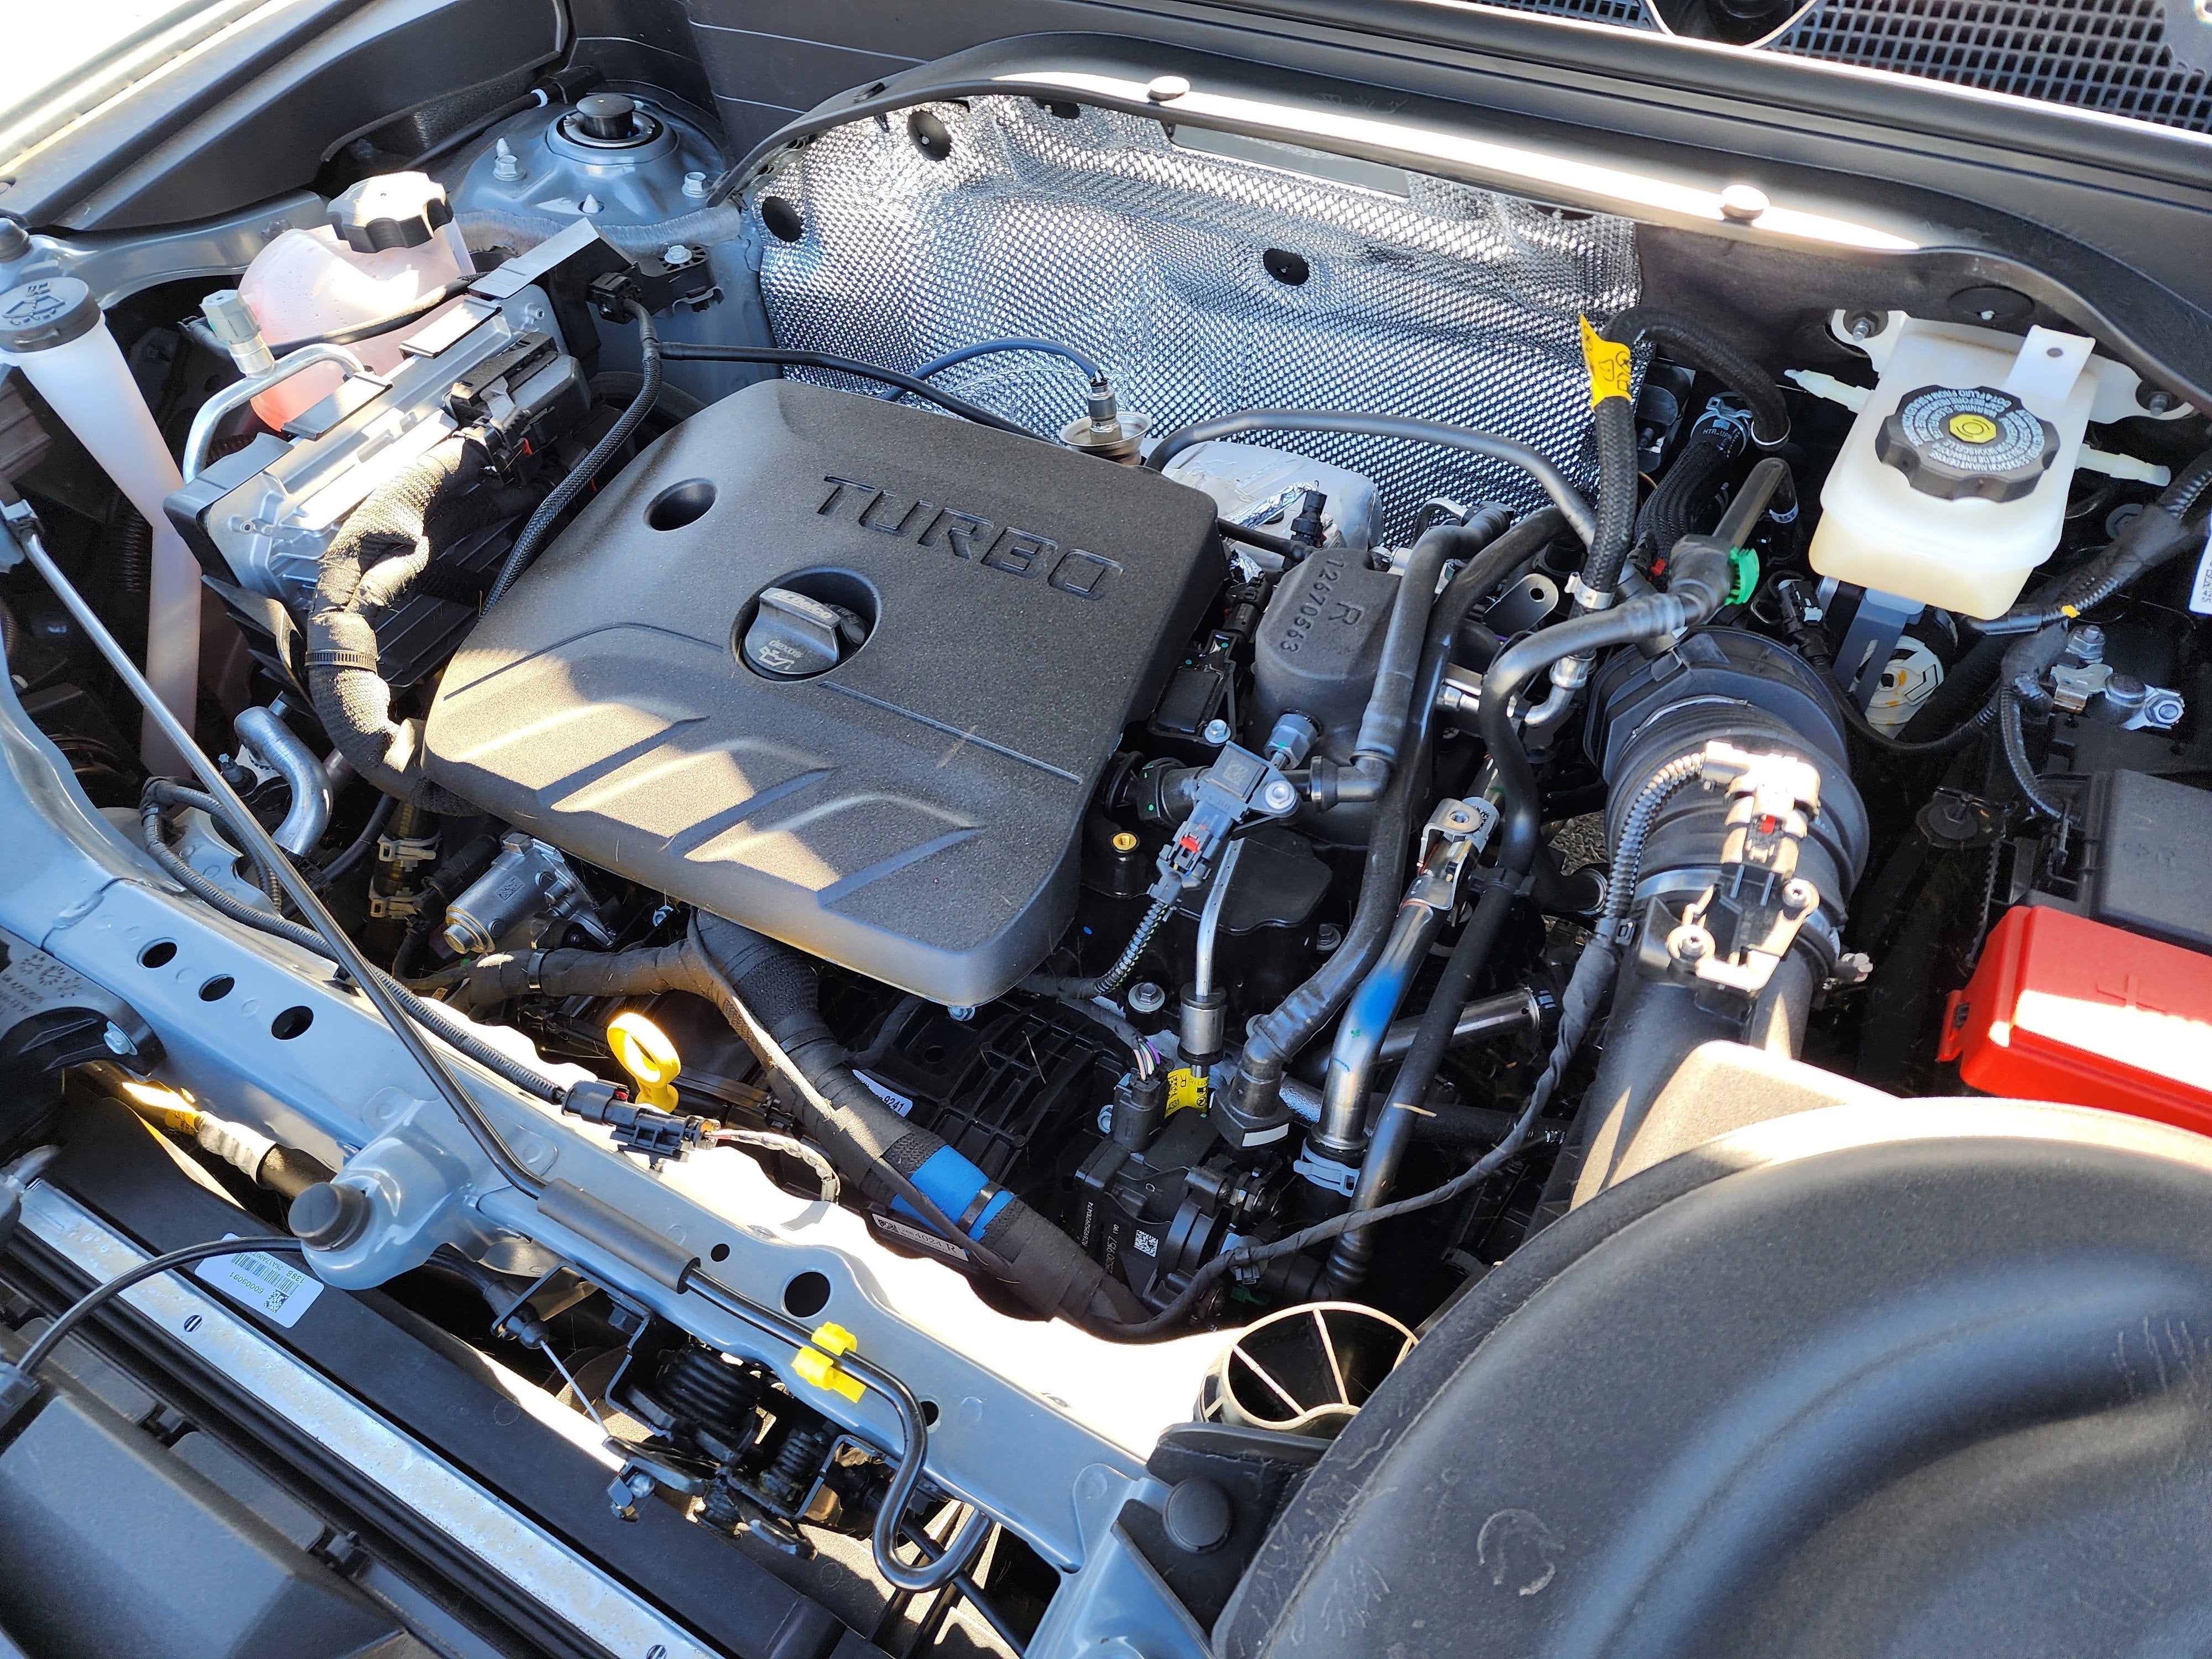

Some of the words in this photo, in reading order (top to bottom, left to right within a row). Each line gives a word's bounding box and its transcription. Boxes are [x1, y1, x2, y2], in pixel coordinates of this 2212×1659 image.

[1927, 389, 1958, 399] FROM
[1957, 389, 1986, 399] FLUID
[817, 474, 1124, 601] TURBO
[1280, 559, 1344, 653] 12670563
[1329, 602, 1363, 625] R
[249, 1252, 284, 1271] 26A17A007
[229, 1271, 264, 1295] 60009091
